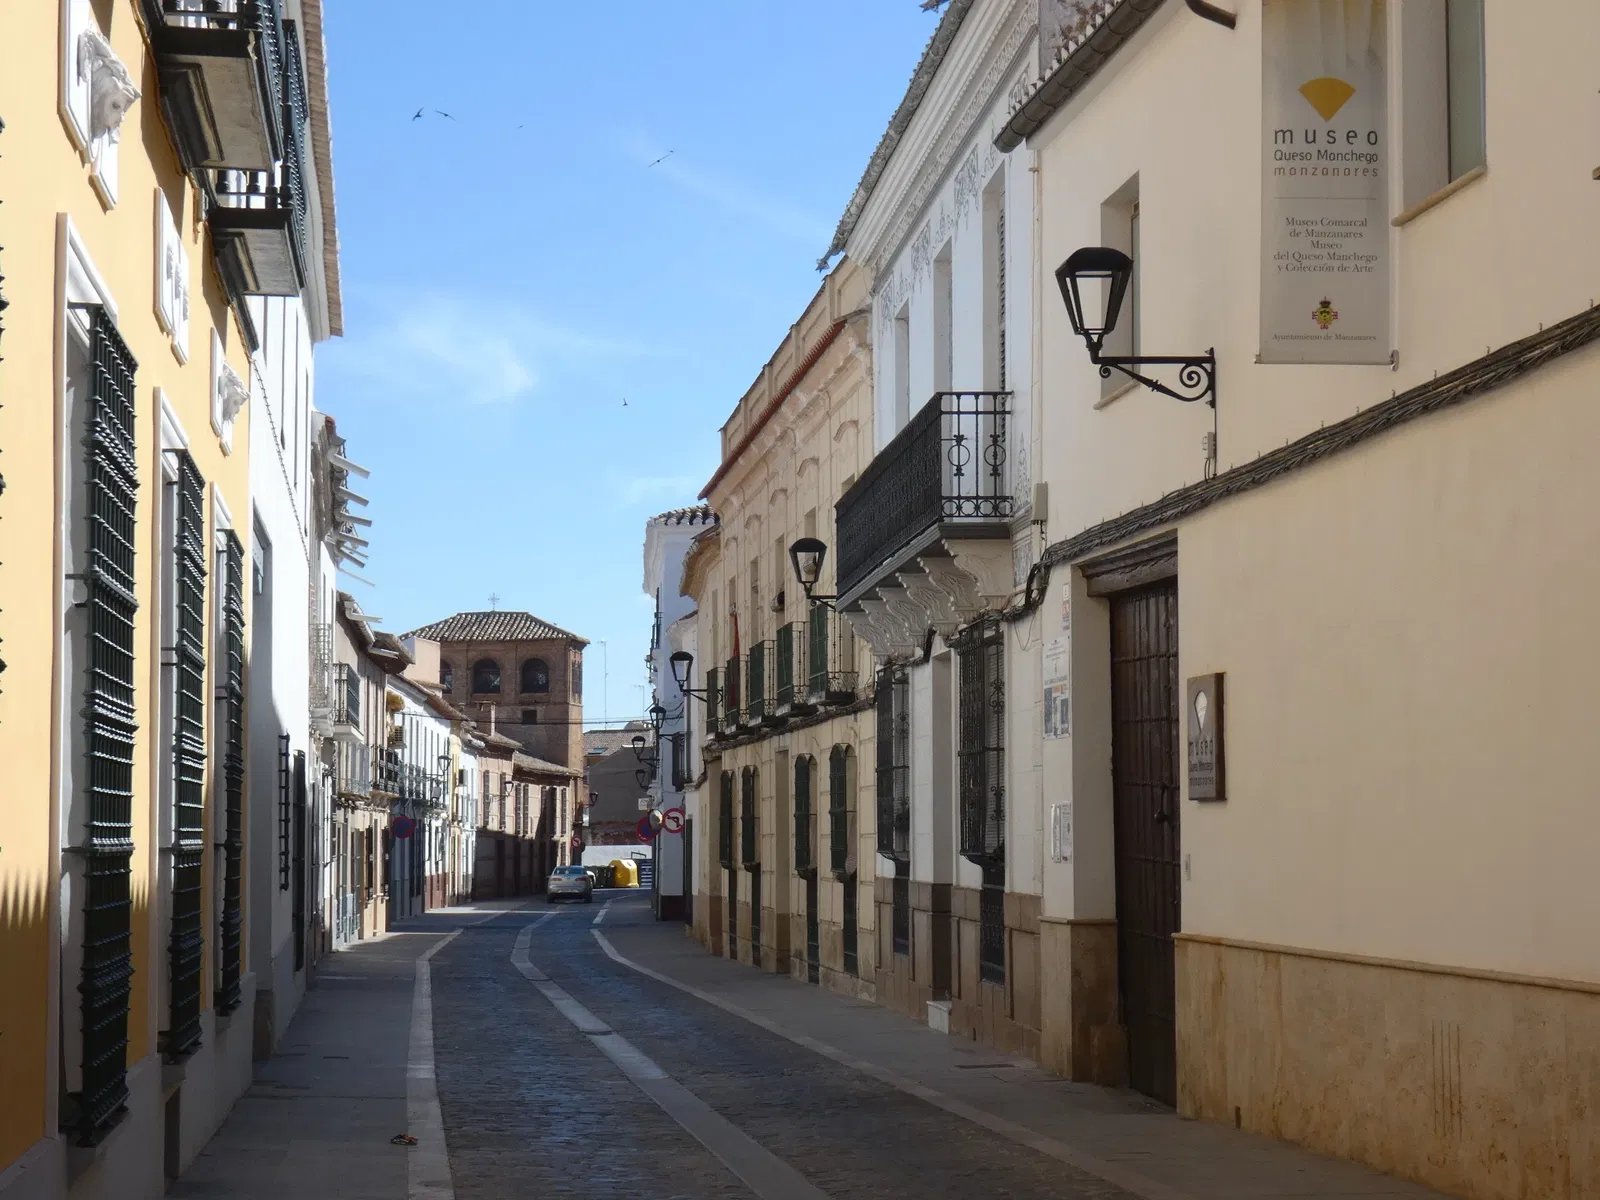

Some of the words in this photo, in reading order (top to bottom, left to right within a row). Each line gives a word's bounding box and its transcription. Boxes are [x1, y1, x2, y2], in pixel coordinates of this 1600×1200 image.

[1274, 129, 1378, 145] museo
[1274, 149, 1313, 161] Queso
[1317, 149, 1379, 164] Manchego
[1274, 167, 1379, 177] manzanares
[1285, 217, 1318, 227] Museo
[1320, 217, 1368, 227] Comarcal
[1289, 228, 1302, 238] de
[1305, 229, 1364, 238] Manzanares
[1310, 240, 1343, 249] Museo
[1273, 251, 1290, 261] del
[1292, 251, 1324, 263] Queso
[1327, 252, 1378, 263] Manchego
[1285, 263, 1335, 273] Colección
[1337, 263, 1350, 272] de
[1352, 263, 1374, 273] Arte
[1323, 333, 1334, 341] de
[1334, 333, 1377, 341] Manzanares
